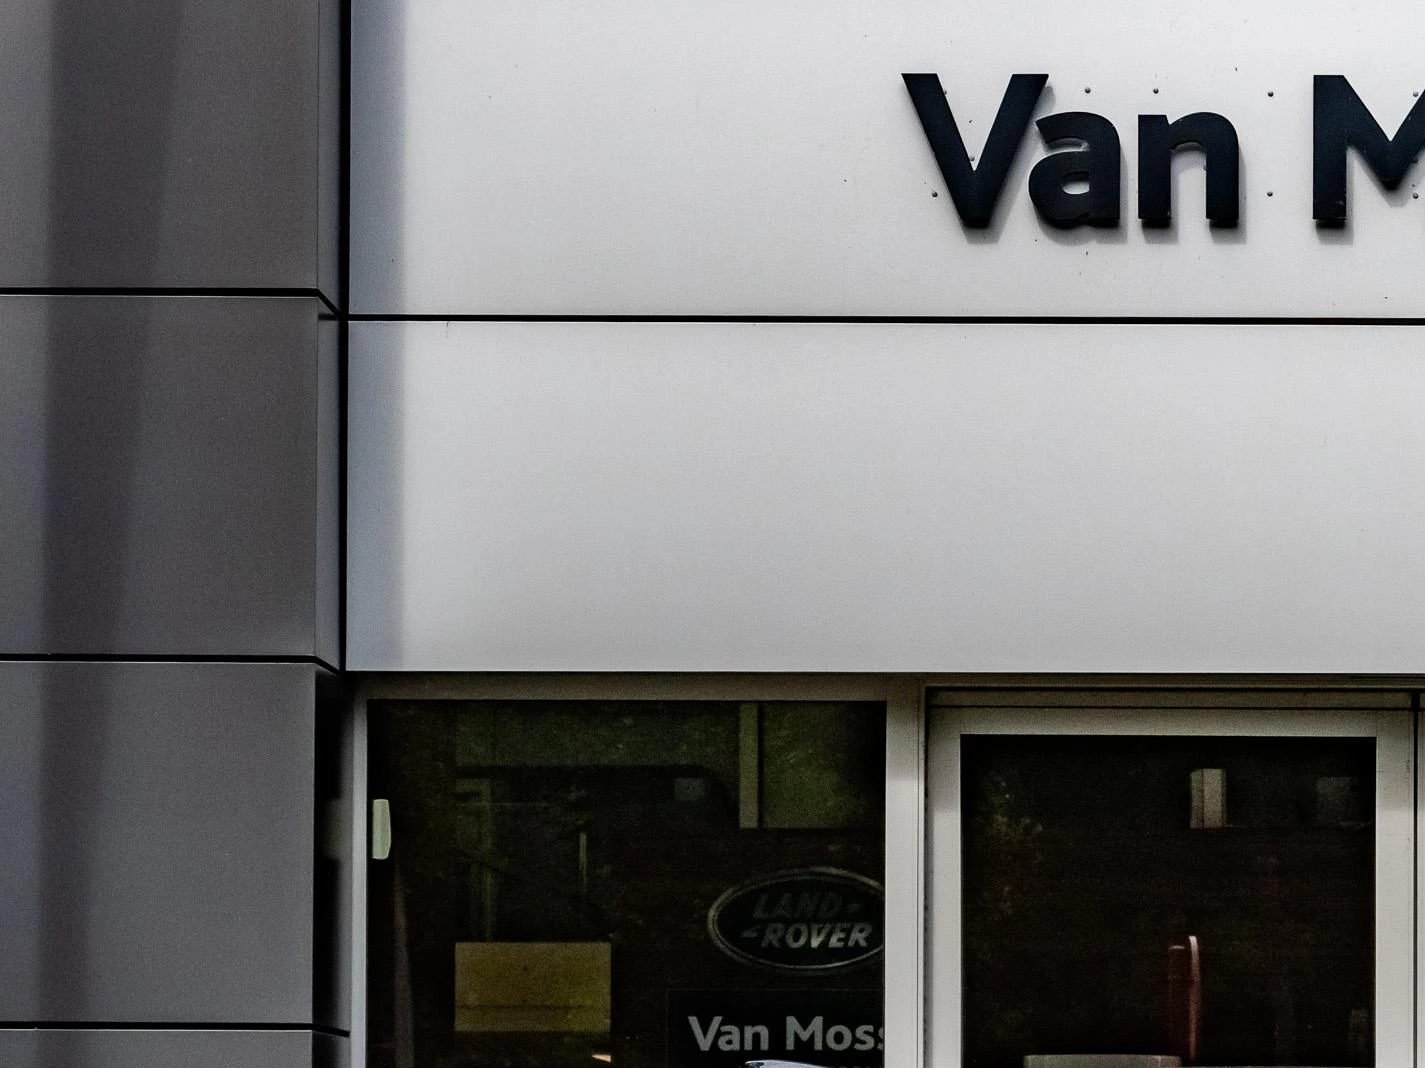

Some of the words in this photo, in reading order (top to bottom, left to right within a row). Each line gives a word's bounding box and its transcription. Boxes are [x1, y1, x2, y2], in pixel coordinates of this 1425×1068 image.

[902, 73, 1240, 229] Van
[752, 892, 842, 920] LAND
[761, 923, 873, 949] ROVER
[688, 1016, 768, 1051] Van
